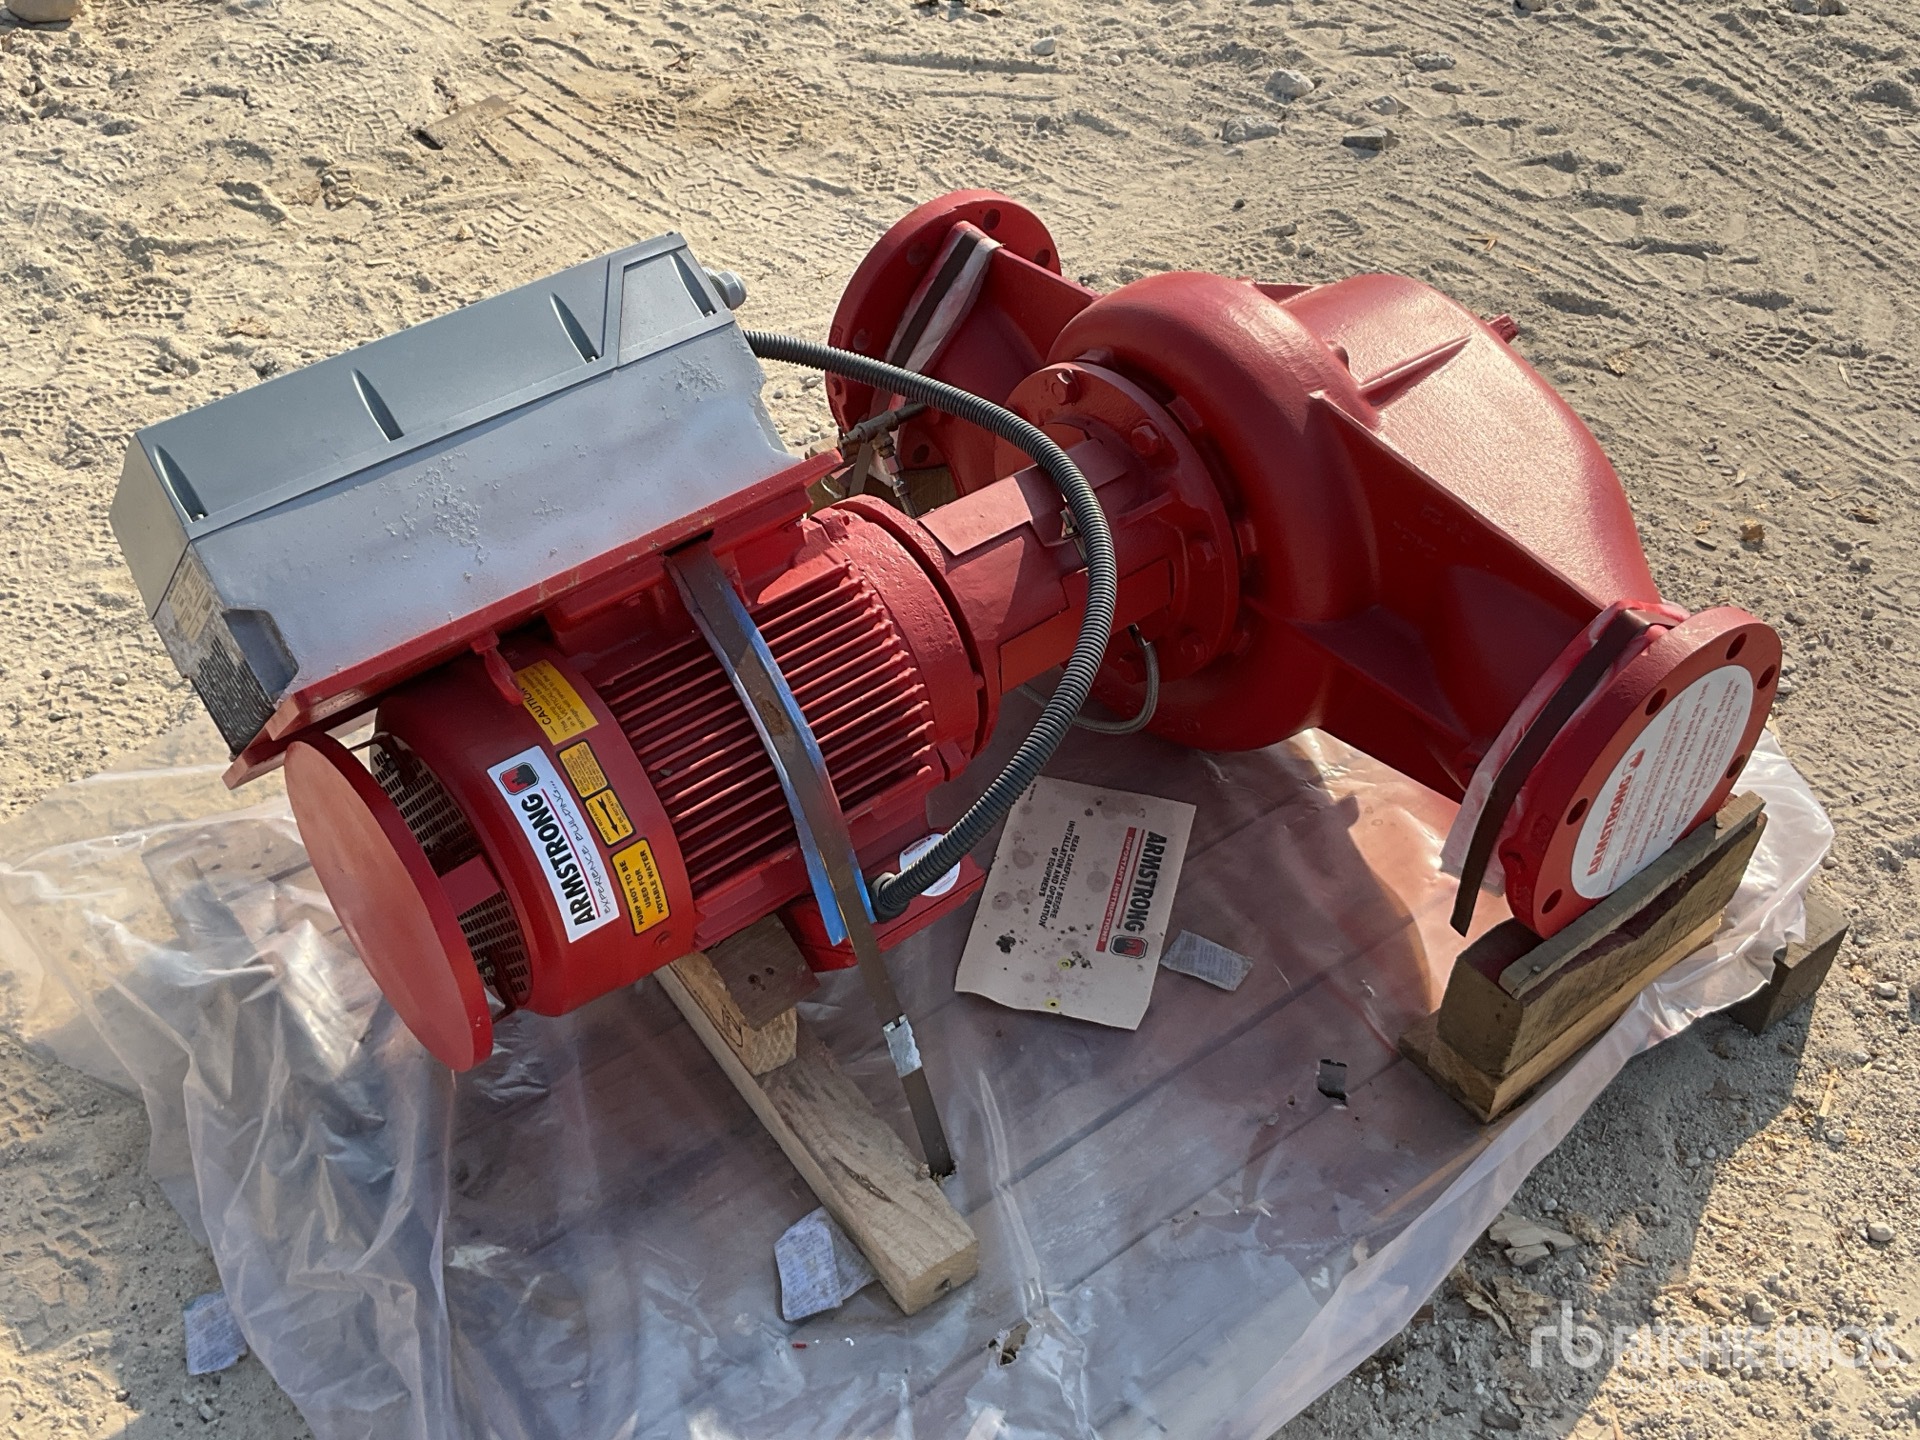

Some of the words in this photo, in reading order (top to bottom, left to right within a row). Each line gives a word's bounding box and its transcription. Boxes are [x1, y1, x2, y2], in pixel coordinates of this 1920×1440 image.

[1668, 796, 1688, 832] ENSURE
[1683, 775, 1696, 795] THE
[1691, 728, 1714, 775] FLUSHING
[1710, 715, 1719, 727] OF
[1716, 678, 1735, 713] ENTIRE
[1679, 789, 1698, 824] SYSTEM
[1694, 750, 1714, 788] BEFORE
[1709, 683, 1741, 748] INSTALLATION
[1634, 830, 1652, 864] ENSURE
[1648, 791, 1667, 828] FLANGE
[1662, 758, 1680, 790] COVER
[1676, 719, 1695, 756] REMAIN
[1691, 703, 1701, 717] ON
[1697, 681, 1710, 702] THE
[1651, 814, 1666, 839] PUMP
[1661, 795, 1673, 812] TILL
[1669, 774, 1681, 793] THE
[1677, 707, 1708, 772] INSTALLATION
[587, 802, 603, 826] ROTATION
[1586, 774, 1633, 877] ARMSTRONG
[521, 793, 596, 926] ARMSTRONG
[1051, 847, 1059, 857] OF
[1056, 820, 1076, 870] INSTALLATION
[1070, 834, 1080, 853] READ
[1117, 836, 1133, 881] IMPORTANT
[619, 860, 629, 873] BE
[624, 874, 632, 886] TO
[635, 868, 645, 886] FOR
[640, 850, 654, 879] WATER
[1038, 857, 1056, 898] EQUIPMENT
[1052, 869, 1061, 885] AND
[1058, 853, 1074, 892] CAREFULLY
[1124, 830, 1167, 934] ARMSTRONG
[629, 887, 639, 904] NOT
[641, 887, 652, 908] USED
[650, 880, 664, 914] POTABLE
[1038, 886, 1056, 928] OPERATION
[1050, 891, 1063, 919] BEFORE
[1100, 881, 1121, 942] INSTRUCTIONS
[635, 905, 644, 926] PUMP
